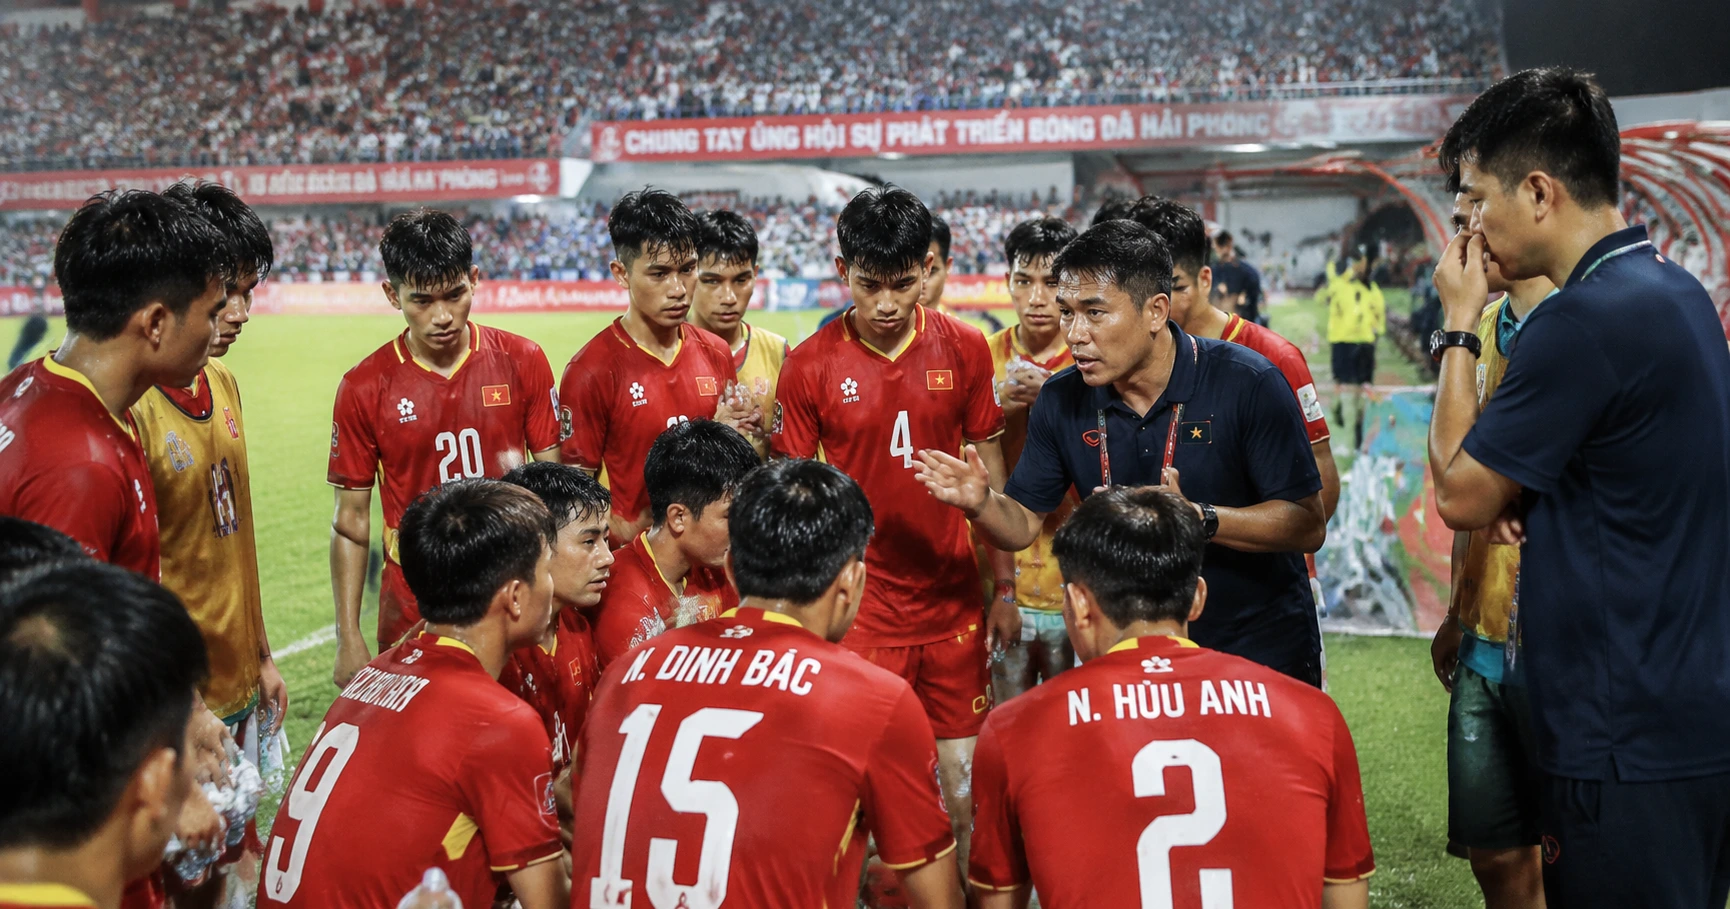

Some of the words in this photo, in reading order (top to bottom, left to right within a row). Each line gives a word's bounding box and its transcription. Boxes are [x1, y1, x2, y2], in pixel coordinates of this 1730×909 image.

[624, 128, 700, 154] CHUNG
[703, 126, 746, 152] TAY
[434, 427, 485, 484] 20
[889, 410, 914, 469] 4
[621, 647, 656, 684] N.
[1067, 687, 1102, 726] N.
[1199, 679, 1272, 718] ANH
[264, 721, 360, 904] 9
[589, 703, 764, 909] 15
[1131, 738, 1235, 909] 2
